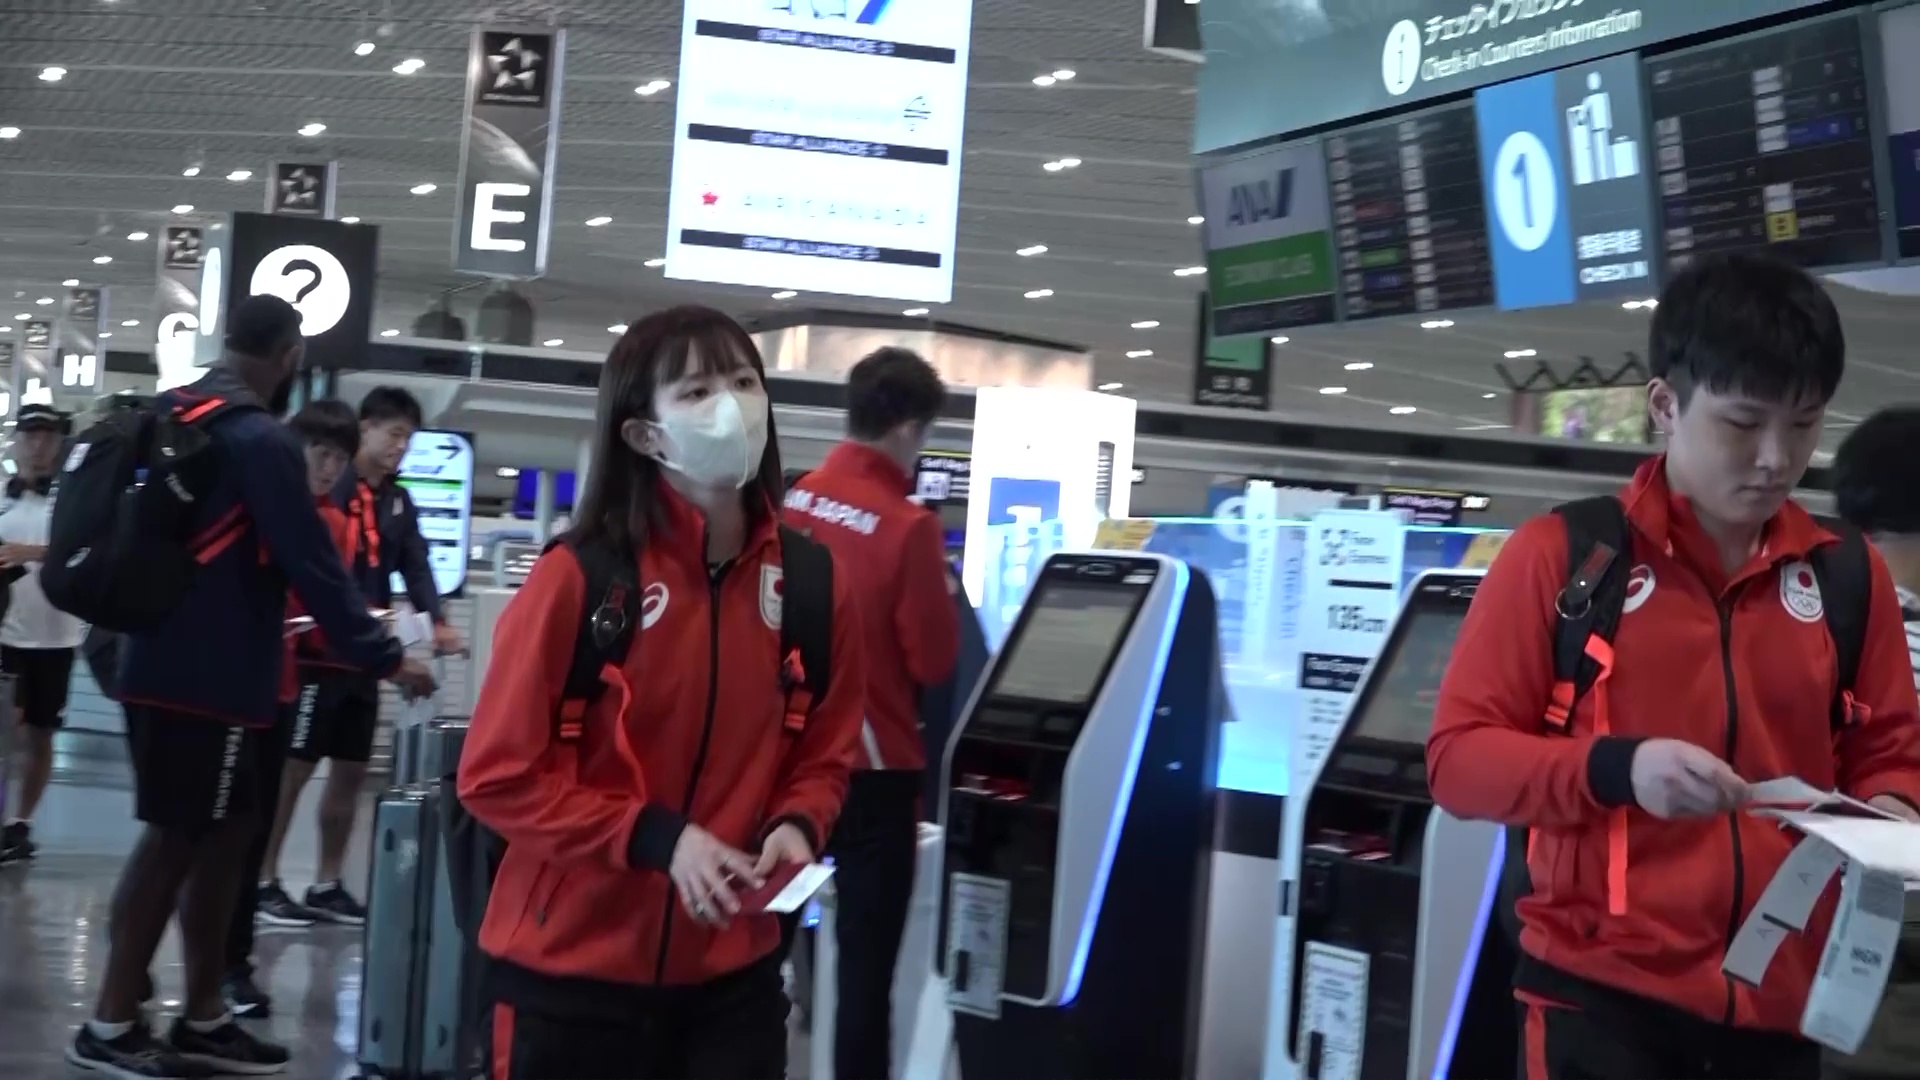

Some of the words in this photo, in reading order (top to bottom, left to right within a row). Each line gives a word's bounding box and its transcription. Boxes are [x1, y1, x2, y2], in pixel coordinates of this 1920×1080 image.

[1511, 153, 1534, 229] 1
[470, 182, 531, 252] E
[63, 354, 97, 387] H
[809, 497, 881, 535] JAPAN
[221, 726, 244, 769] TEAM
